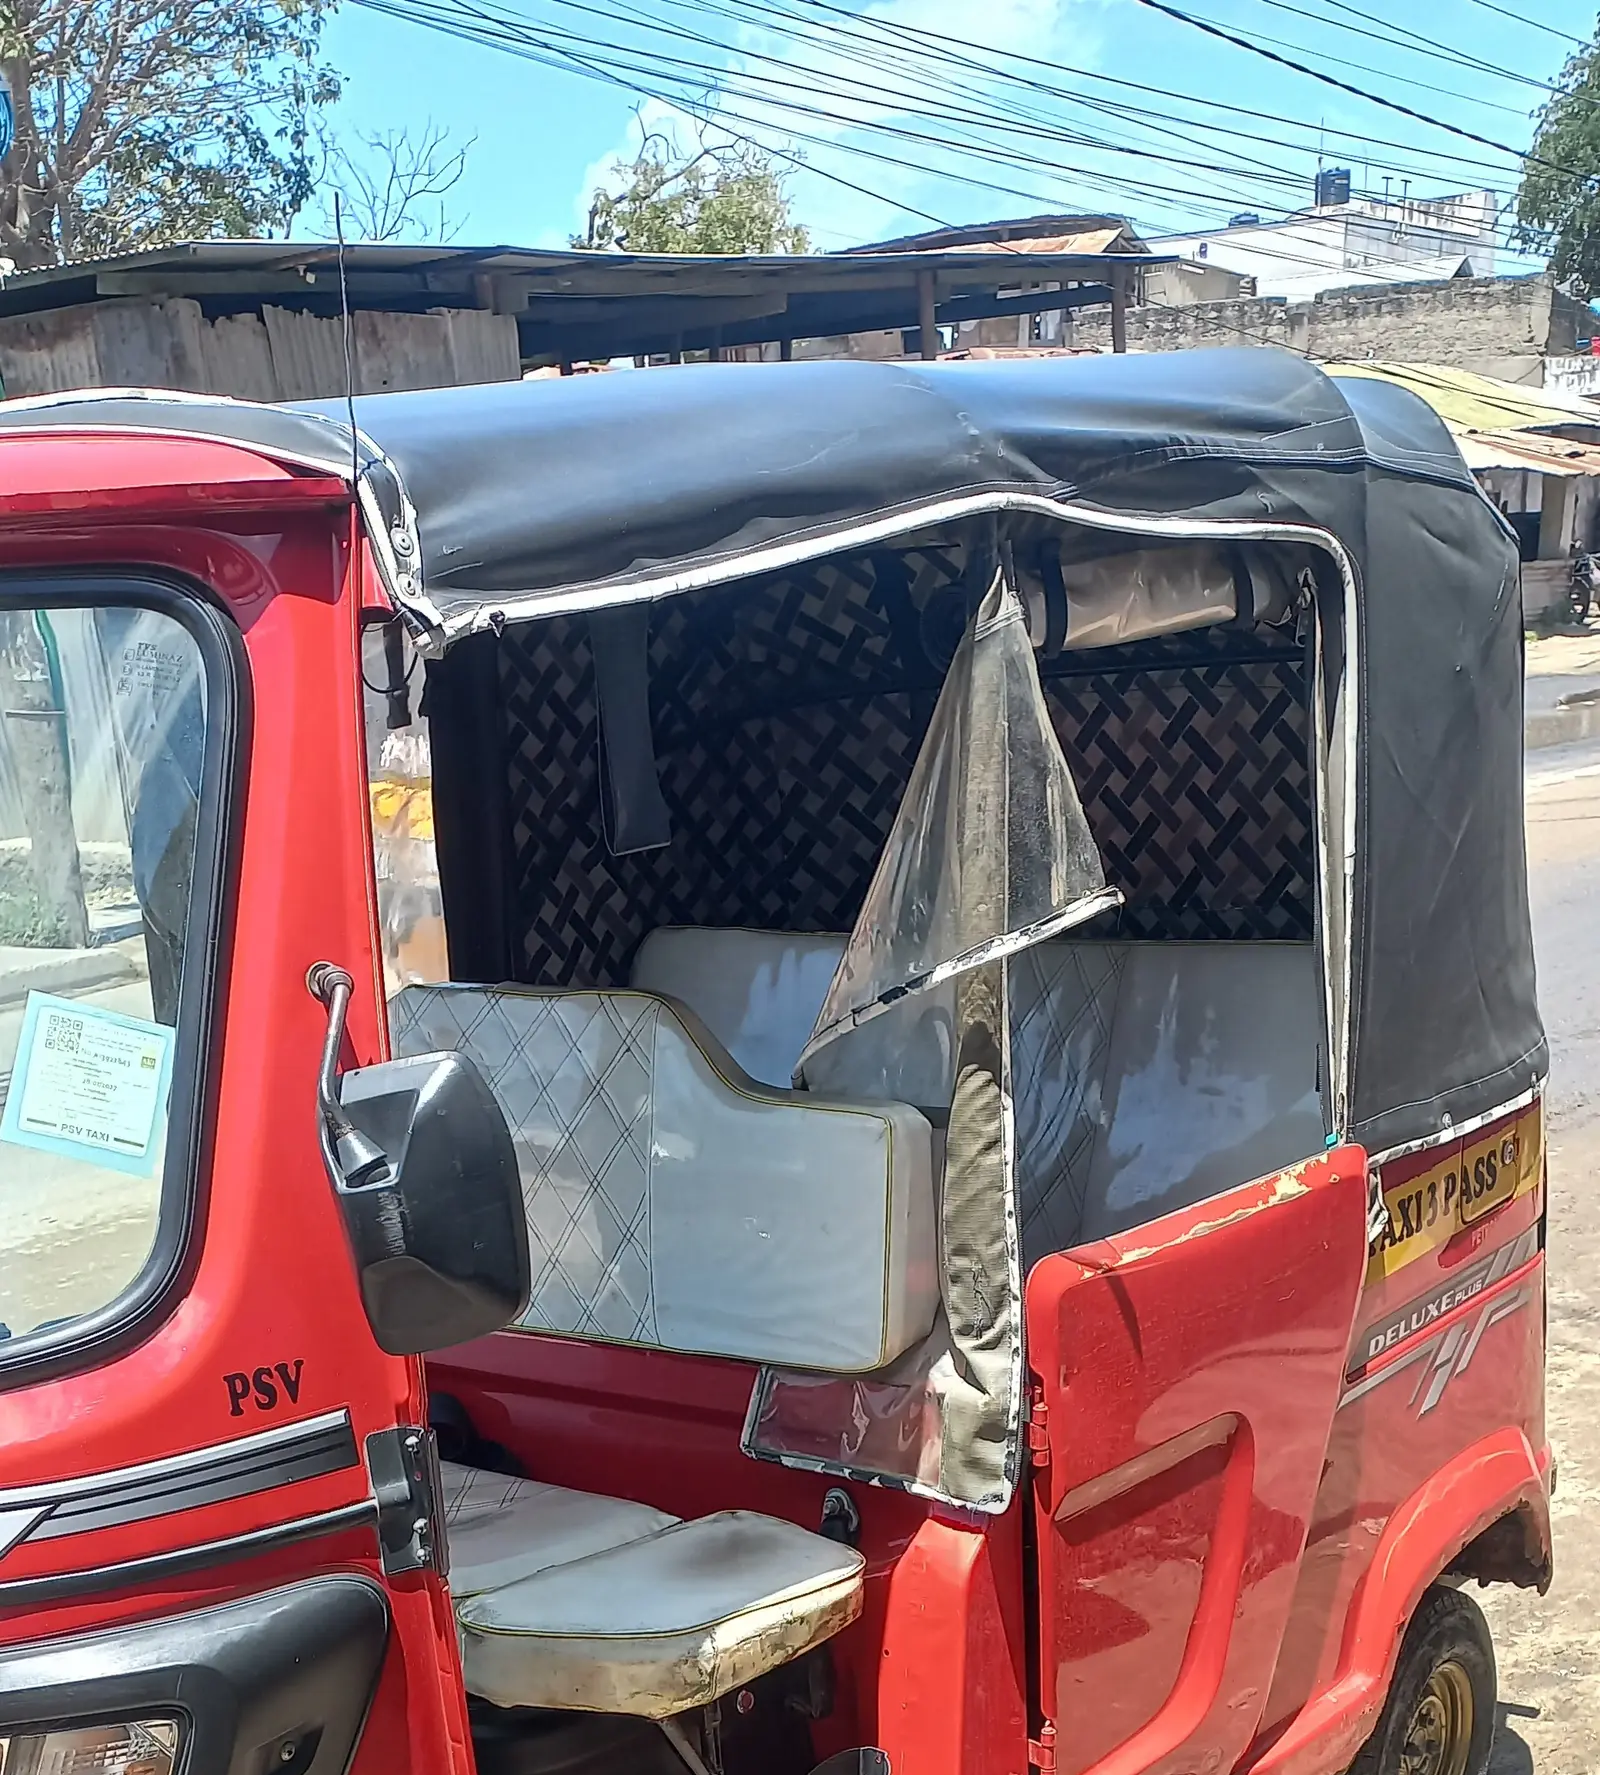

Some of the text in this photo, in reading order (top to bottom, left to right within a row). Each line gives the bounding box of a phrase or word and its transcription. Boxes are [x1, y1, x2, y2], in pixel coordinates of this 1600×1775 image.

[60, 1123, 110, 1142] PSV TAXI
[1370, 1189, 1423, 1258] AXI
[1426, 1181, 1438, 1228] 3
[1443, 1149, 1497, 1217] PASS
[1368, 1279, 1485, 1357] DELUXE PLUS
[222, 1358, 305, 1418] PSV
